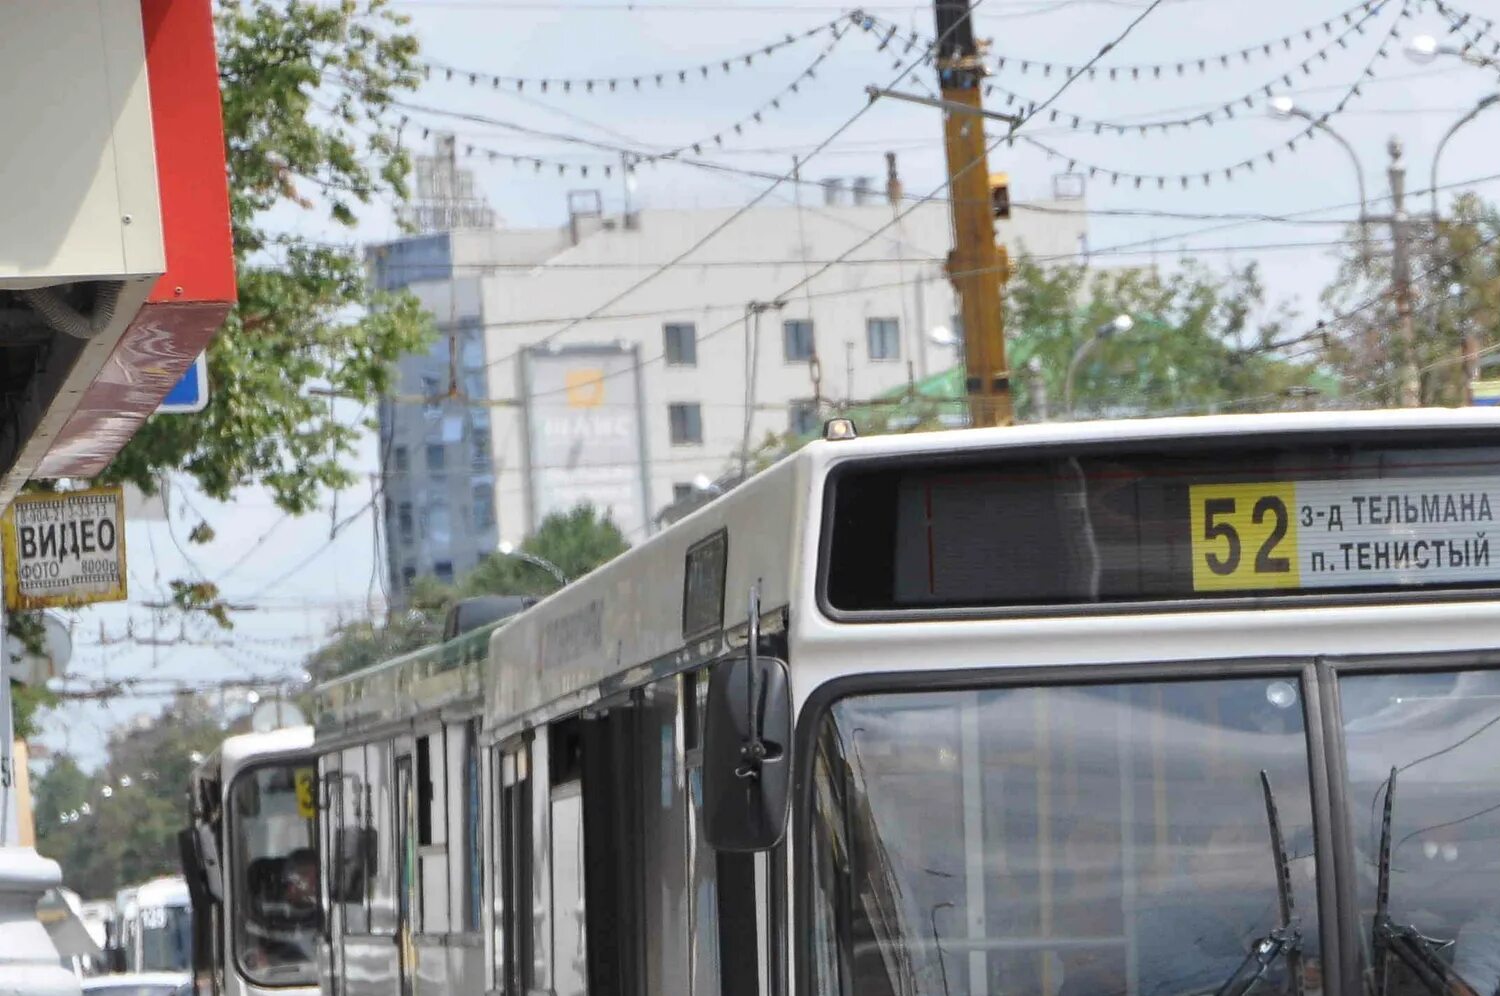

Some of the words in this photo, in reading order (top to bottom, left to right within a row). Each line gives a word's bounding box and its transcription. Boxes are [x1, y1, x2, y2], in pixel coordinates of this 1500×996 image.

[1301, 505, 1343, 531] з-д
[1352, 493, 1493, 525] ТЕЛЬМАНА
[20, 518, 116, 563] ВИДЕО
[1203, 495, 1291, 576] 52
[21, 560, 60, 581] ФОТО
